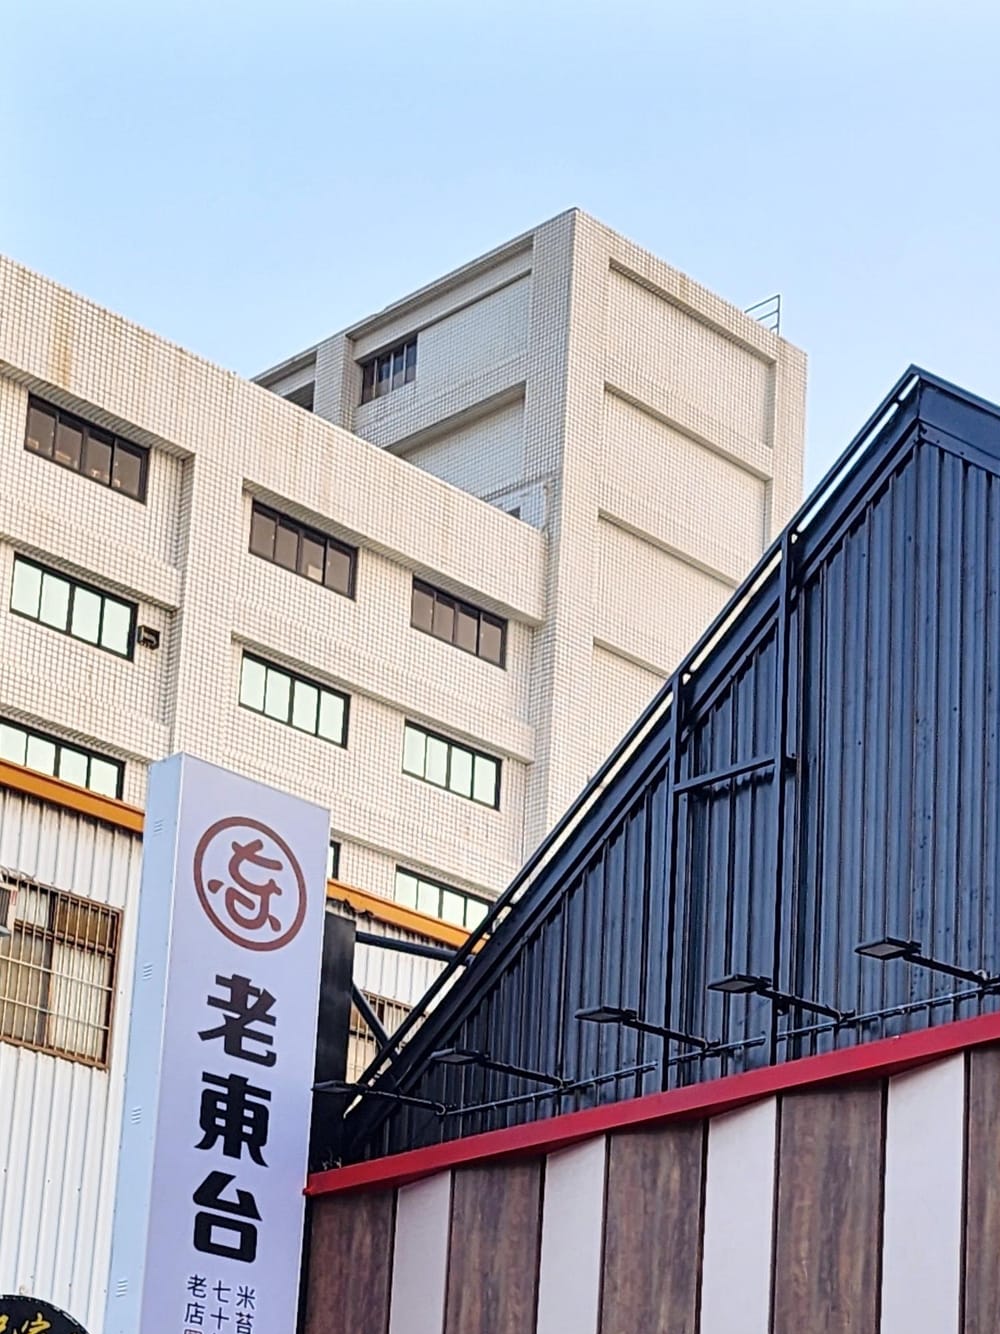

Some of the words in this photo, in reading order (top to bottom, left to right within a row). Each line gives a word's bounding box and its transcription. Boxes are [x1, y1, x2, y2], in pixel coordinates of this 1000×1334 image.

[193, 973, 277, 1263] 老東台
[184, 1274, 207, 1326] 老店
